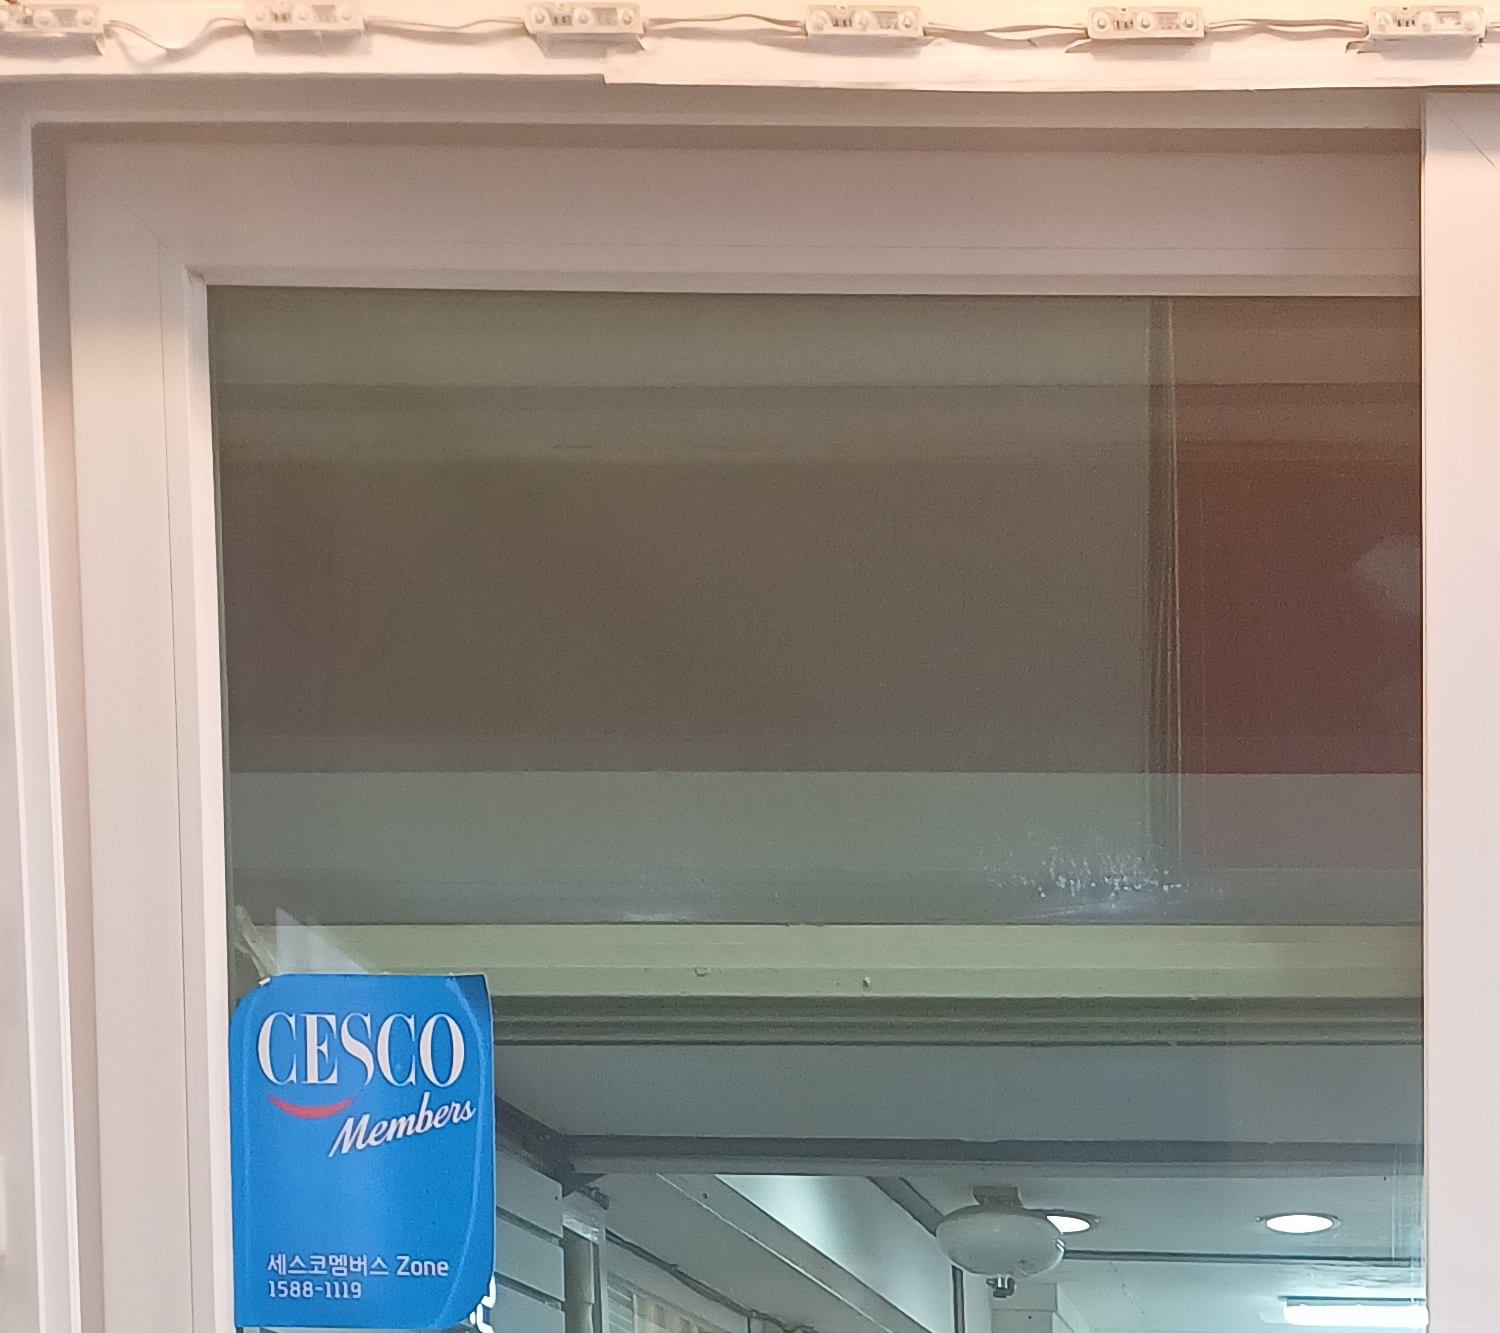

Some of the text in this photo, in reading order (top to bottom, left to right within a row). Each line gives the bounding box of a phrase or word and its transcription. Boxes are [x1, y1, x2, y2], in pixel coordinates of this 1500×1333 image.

[257, 1012, 465, 1088] CESCO
[328, 1091, 477, 1158] Members
[267, 1253, 450, 1277] 세스코멤버스 Zone
[267, 1280, 362, 1299] 1588-1119
